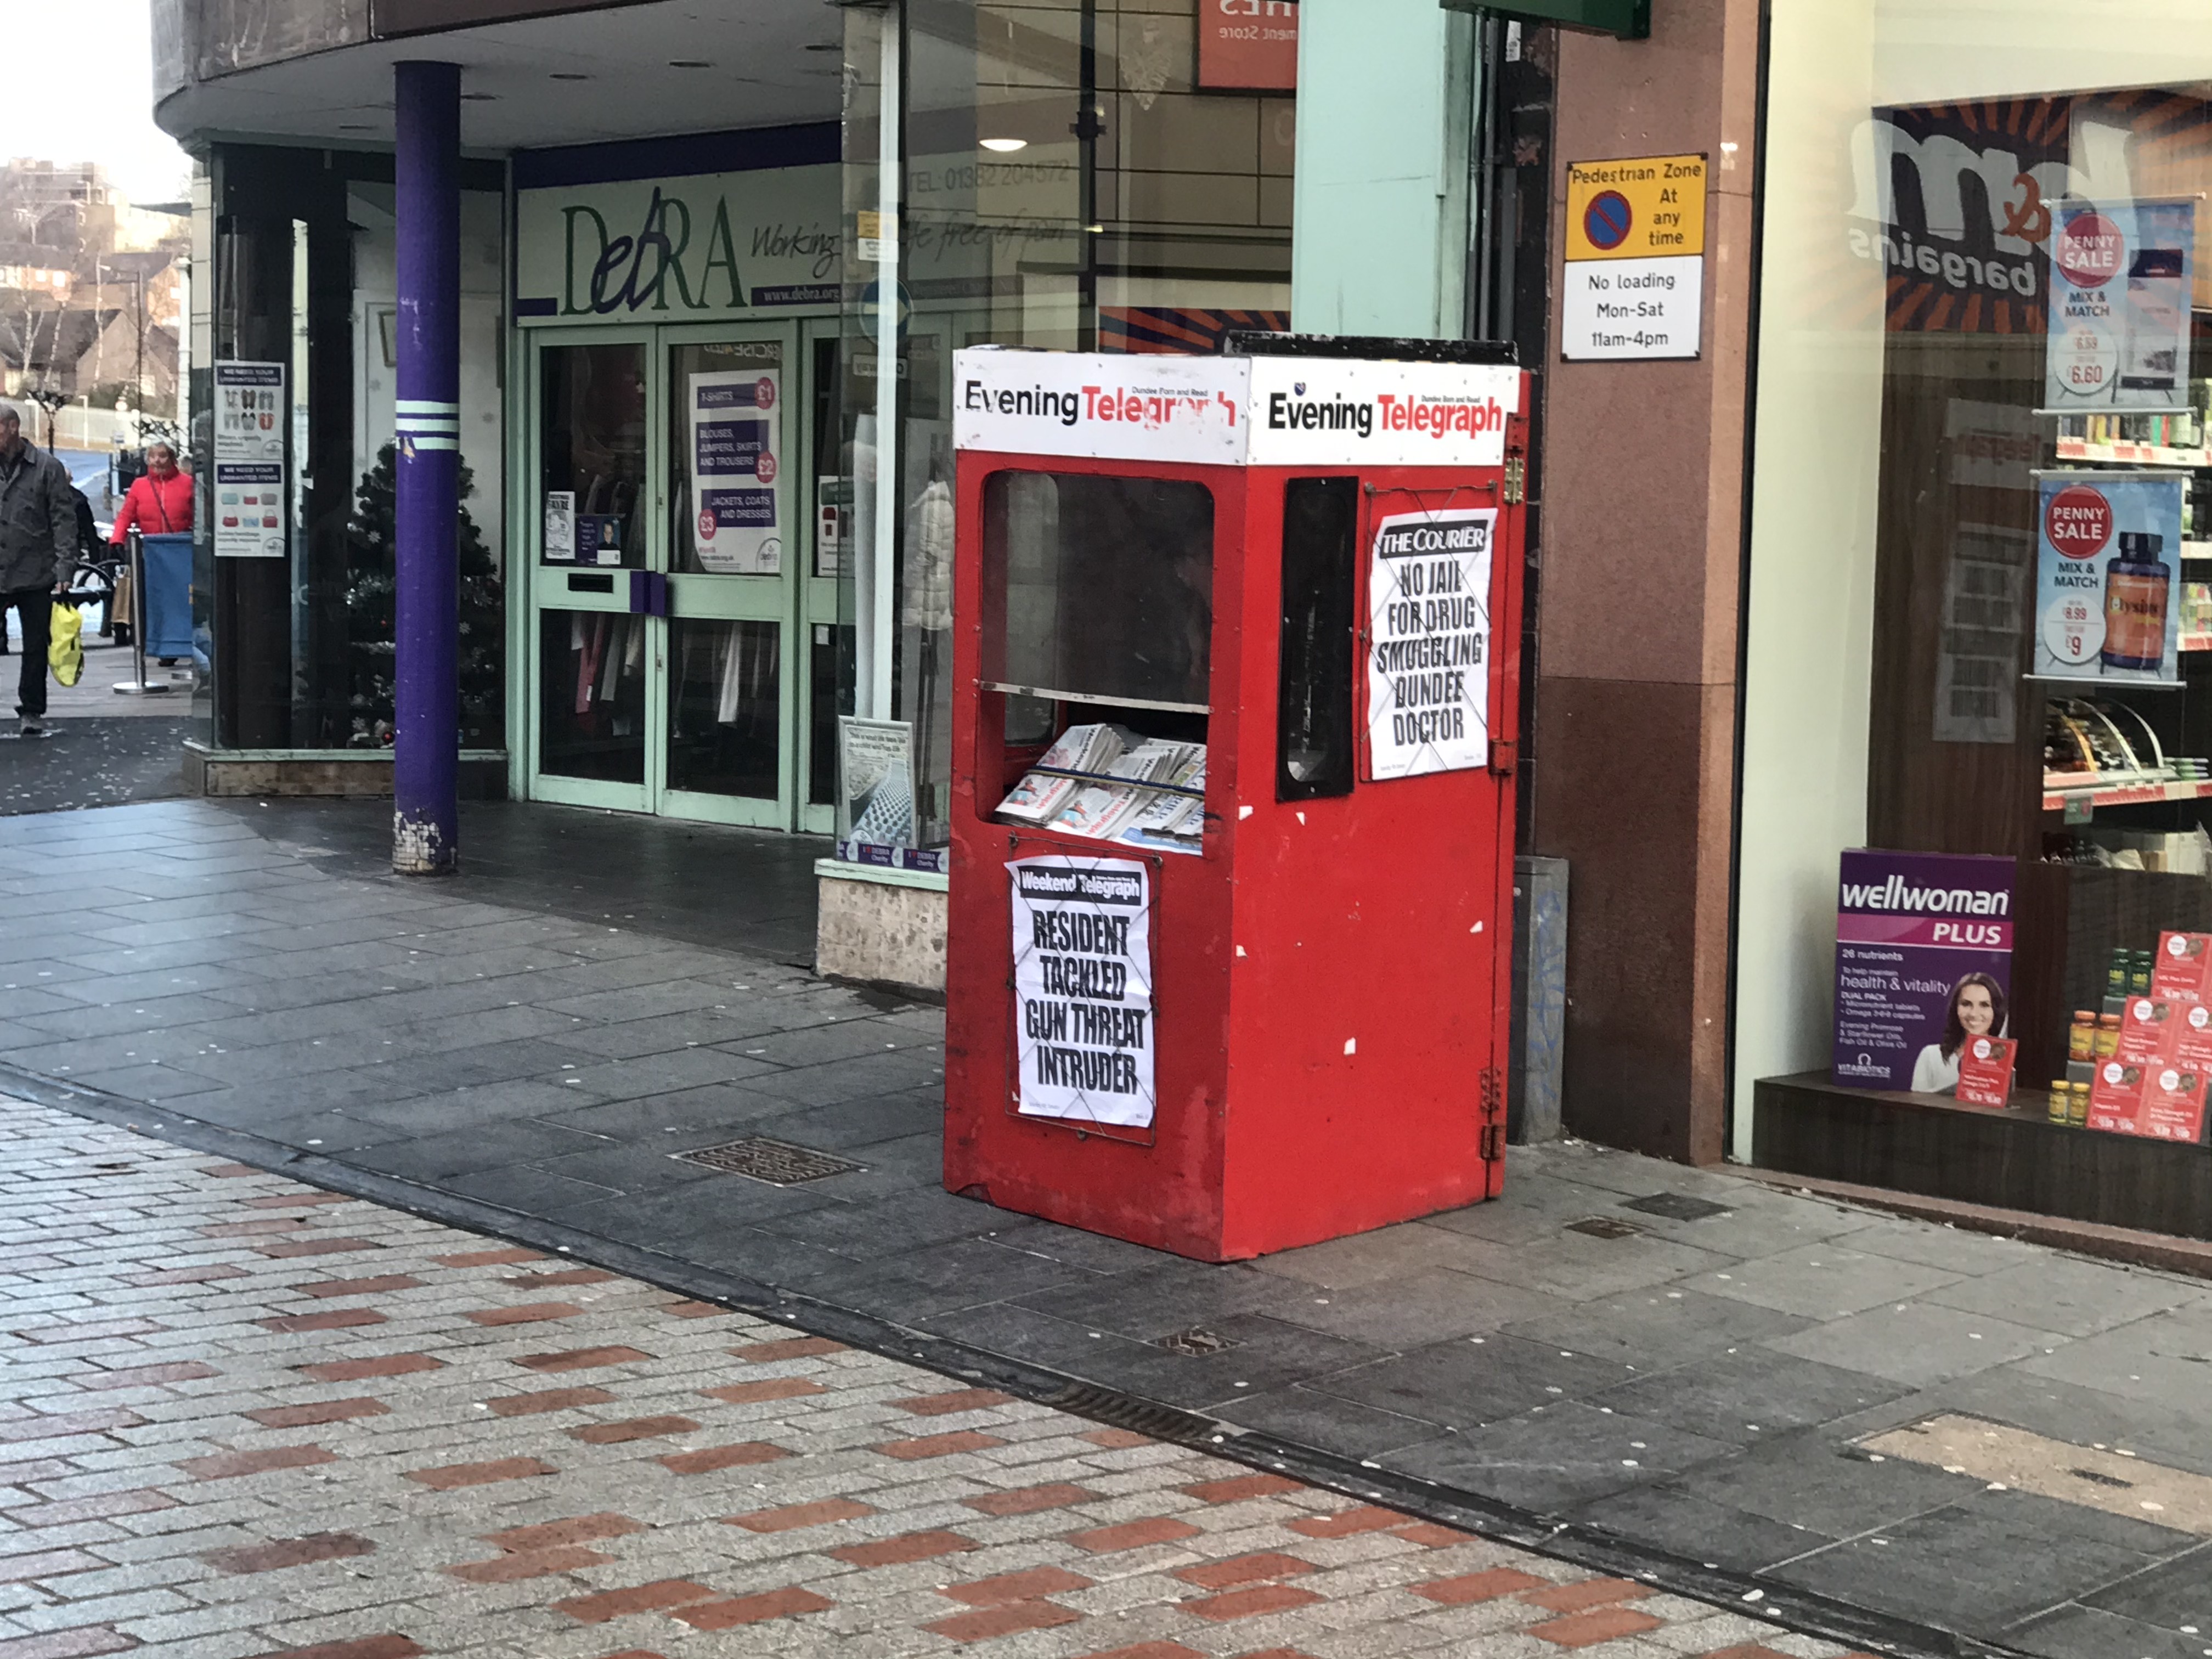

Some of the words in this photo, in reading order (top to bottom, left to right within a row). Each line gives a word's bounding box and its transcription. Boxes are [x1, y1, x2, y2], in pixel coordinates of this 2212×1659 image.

[1572, 167, 1655, 184] Pedestrian
[1663, 163, 1702, 179] Zone
[1660, 188, 1678, 204] At
[1653, 211, 1680, 226] any
[1649, 230, 1684, 246] time
[2064, 236, 2115, 248] PENNY
[751, 222, 842, 279] Working
[2065, 251, 2113, 268] SALE
[1589, 275, 1610, 290] No
[1617, 273, 1675, 290] loading
[2069, 292, 2094, 302] MIX
[2097, 291, 2106, 302] &
[1597, 302, 1664, 318] Mon-Sat
[2065, 306, 2109, 317] MATCH
[1592, 331, 1669, 348] 11am-4pm
[757, 385, 772, 401] £1
[966, 381, 1078, 426] Evening
[1268, 392, 1372, 438] Evening
[1378, 394, 1502, 439] Telegraph
[700, 458, 715, 466] AND
[716, 456, 754, 466] TROUSERS
[758, 459, 774, 476] £2
[745, 496, 771, 505] COATS
[720, 510, 736, 518] AND
[736, 509, 771, 519] DRESSES
[2053, 507, 2104, 520] PENNY
[699, 516, 714, 532] £3
[2054, 522, 2102, 540] SALE
[1383, 532, 1413, 554] THE
[1413, 527, 1485, 551] COURIER
[2058, 562, 2082, 573] MIX
[2086, 563, 2095, 574] &
[1400, 562, 1424, 597] NO
[1428, 560, 1462, 594] JAIL
[2054, 576, 2098, 588] MATCH
[1387, 601, 1421, 636] FOR
[1427, 596, 1475, 631] DRUG
[1377, 632, 1482, 674] SMUGGLING
[1396, 671, 1465, 708] DUNDEE
[1393, 708, 1464, 746] DOCTOR
[1022, 871, 1076, 892] Weekend
[1077, 874, 1140, 900] Telegraph
[1842, 874, 2009, 916] wellwoman
[1032, 910, 1130, 956] RESIDENT
[1933, 922, 2002, 945] PLUS
[1858, 950, 1904, 961] nutrients
[1040, 955, 1127, 1001] TACKLED
[1841, 974, 1887, 990] health
[1889, 977, 1901, 990] &
[1903, 978, 1951, 997] vitality
[1025, 998, 1066, 1042] GUN
[1071, 1003, 1146, 1049] THREAT
[1037, 1045, 1138, 1095] INTRUDER
